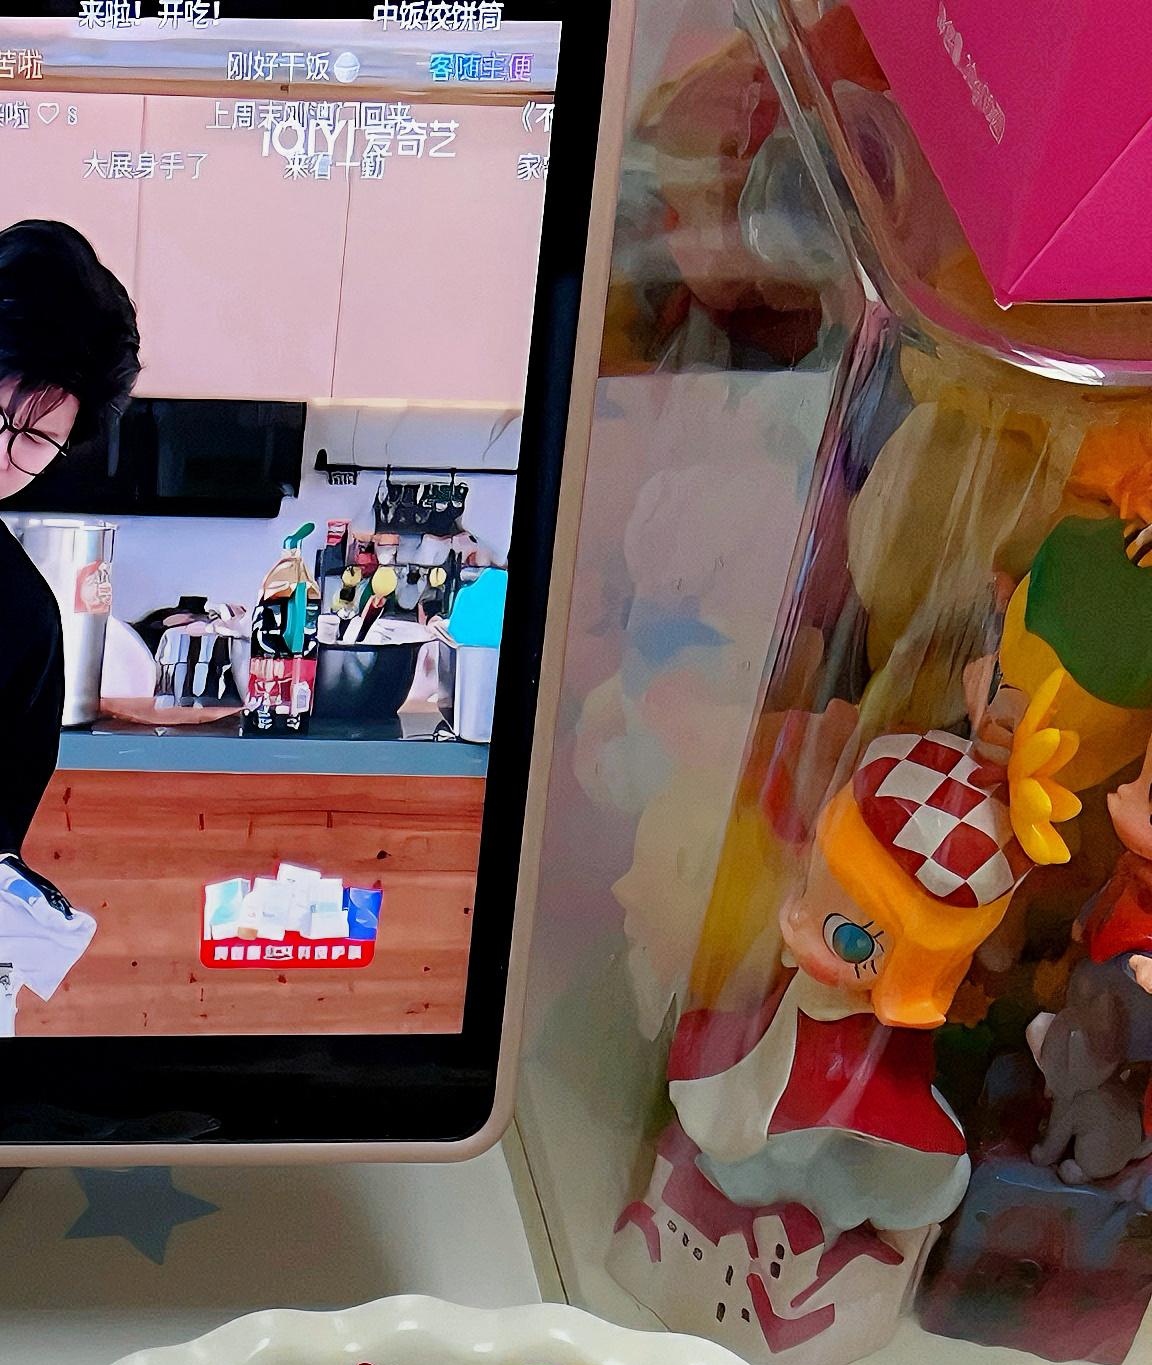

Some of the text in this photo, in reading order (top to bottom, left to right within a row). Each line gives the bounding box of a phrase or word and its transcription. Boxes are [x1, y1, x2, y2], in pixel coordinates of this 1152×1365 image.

[227, 50, 330, 82] 刚好干饭
[83, 149, 209, 180] 大展身手了
